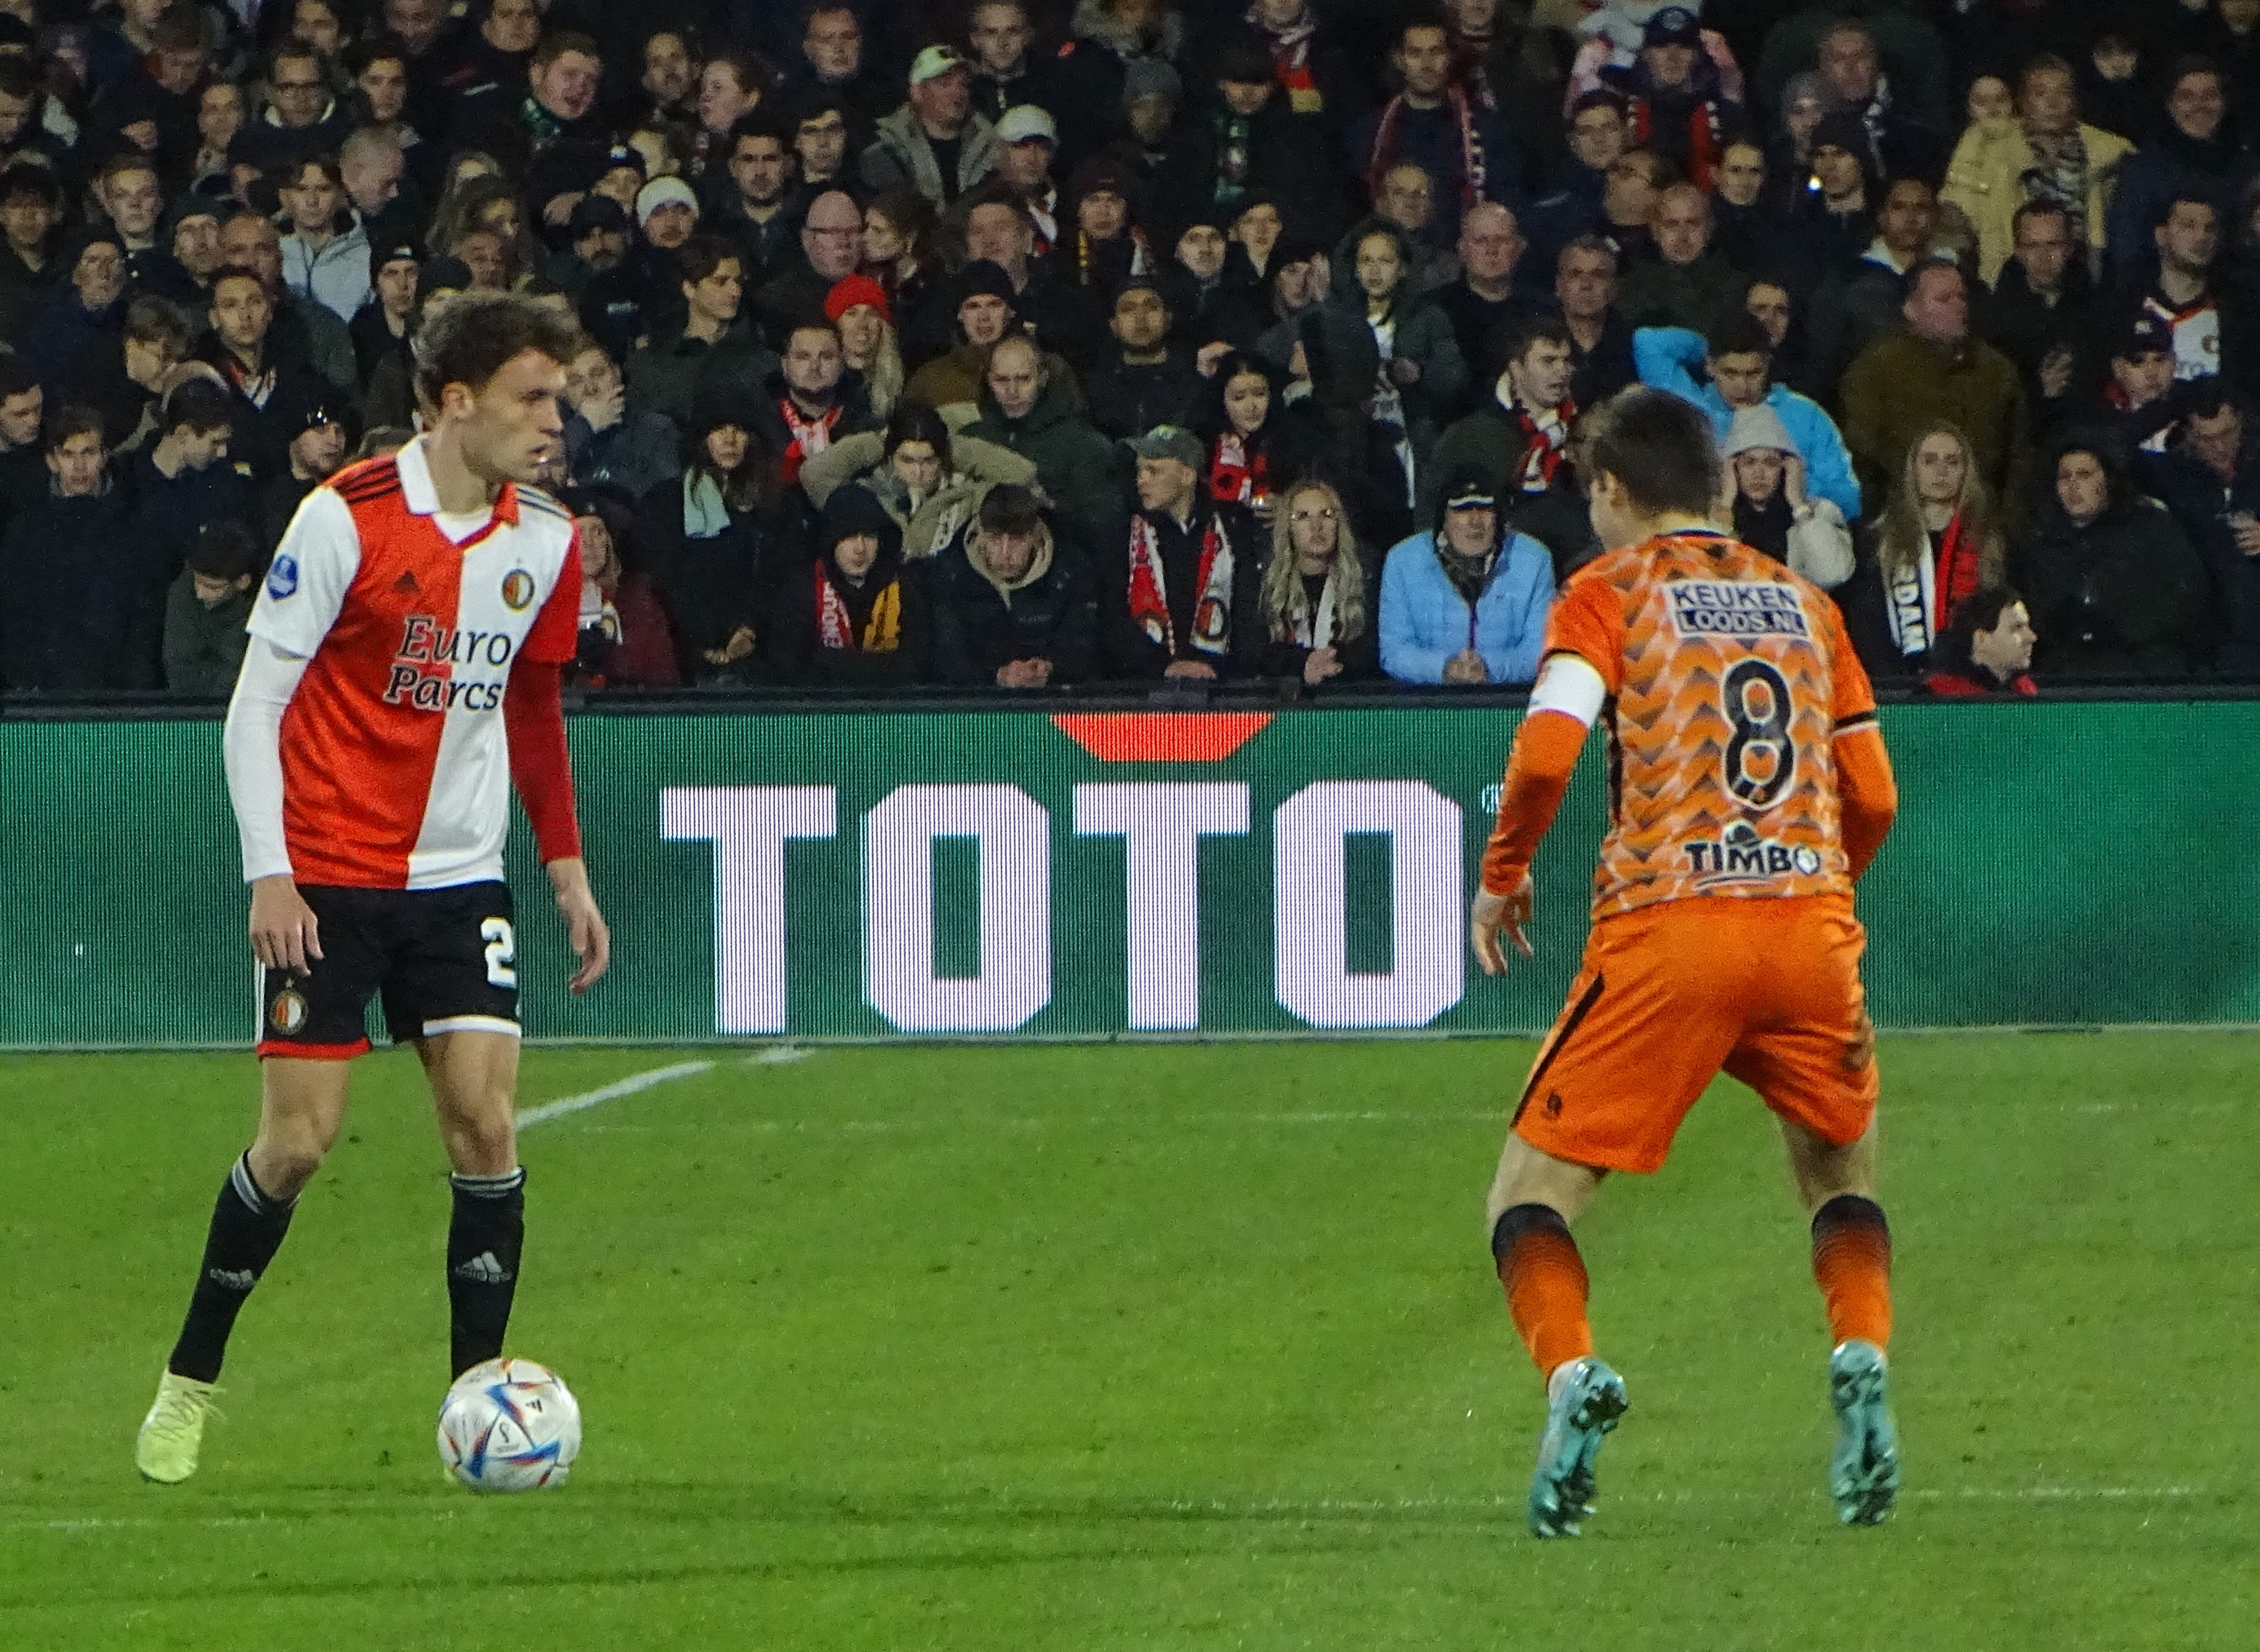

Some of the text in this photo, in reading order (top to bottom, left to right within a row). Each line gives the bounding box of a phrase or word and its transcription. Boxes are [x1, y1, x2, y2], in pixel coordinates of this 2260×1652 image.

[1672, 584, 1798, 609] KEUKEN
[394, 615, 512, 667] Euro
[383, 663, 502, 712] Parcs
[1724, 659, 1795, 808] 8
[1684, 839, 1821, 875] TIMBO
[659, 779, 1464, 1034] TOTO
[480, 917, 517, 988] 2
